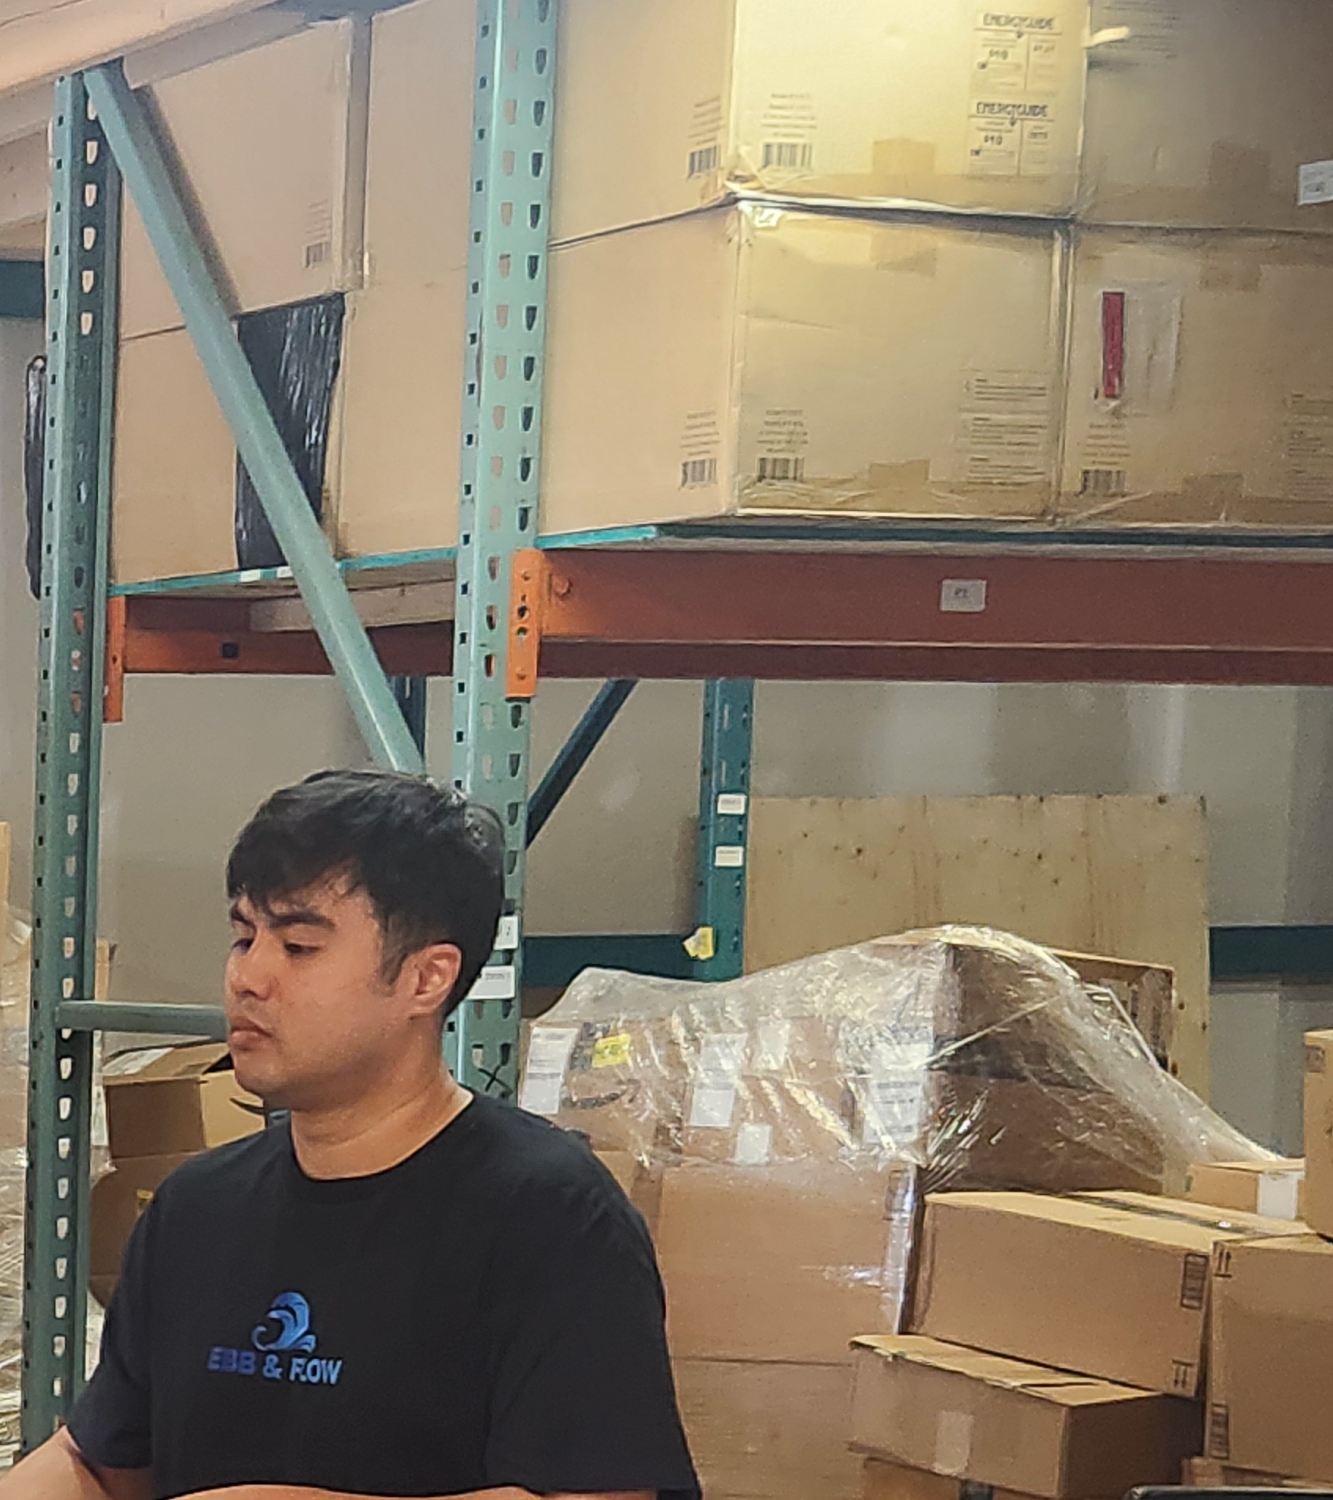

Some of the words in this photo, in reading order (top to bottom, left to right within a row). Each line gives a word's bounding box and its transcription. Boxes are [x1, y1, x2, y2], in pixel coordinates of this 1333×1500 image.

[208, 1348, 255, 1375] EBB
[263, 1354, 282, 1379] &
[289, 1357, 342, 1384] FLOW
